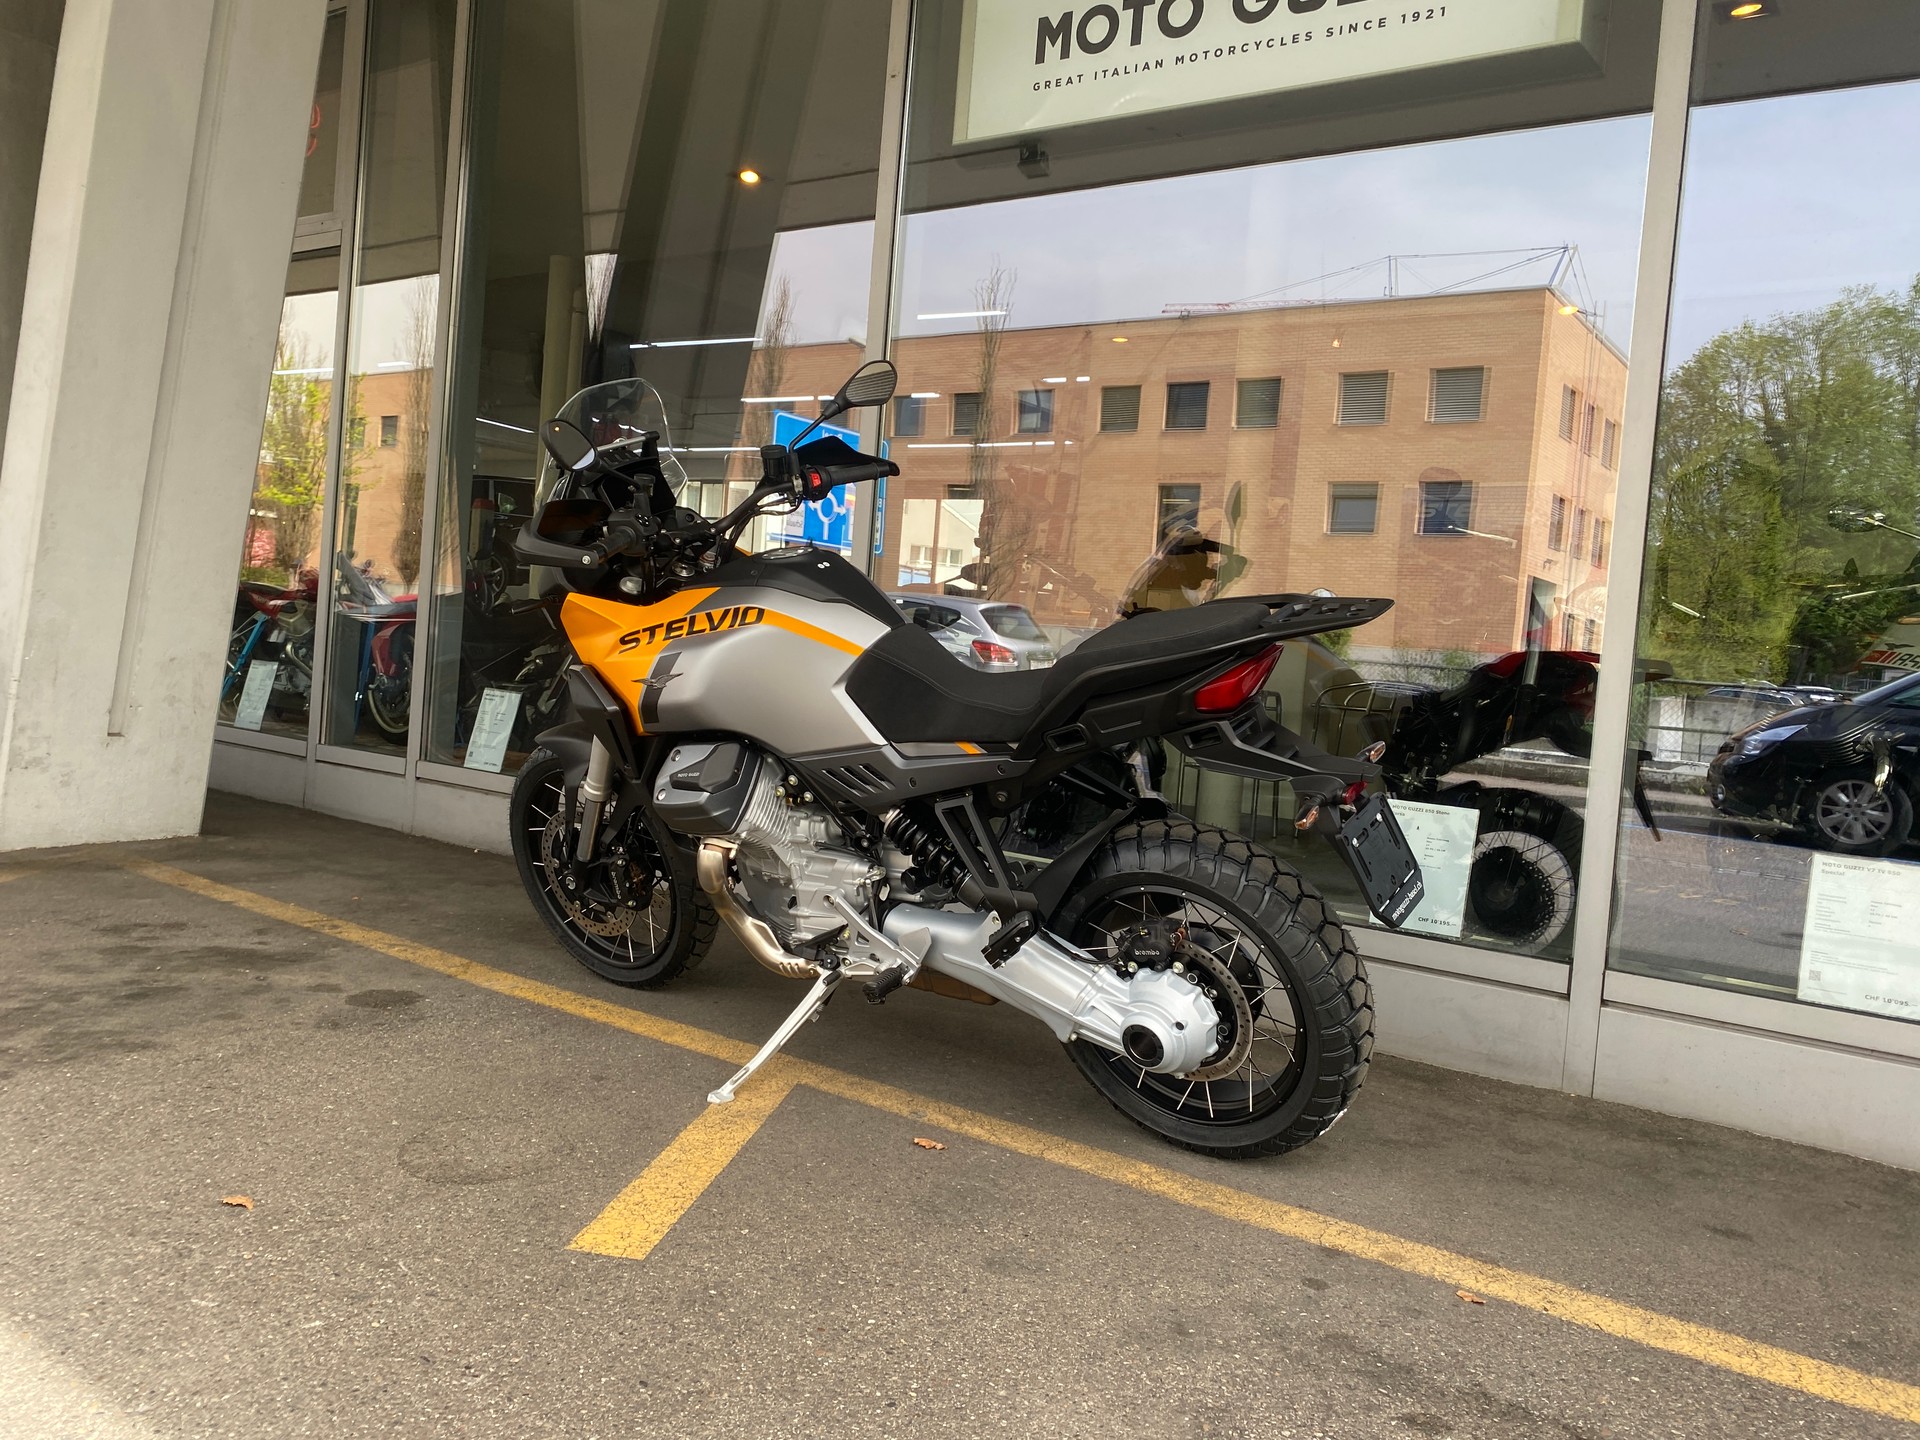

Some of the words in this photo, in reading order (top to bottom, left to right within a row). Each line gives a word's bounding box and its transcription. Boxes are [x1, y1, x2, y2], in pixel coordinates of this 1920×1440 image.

[1033, 74, 1084, 91] GREAT
[1094, 59, 1164, 81] ITALIAN
[1175, 32, 1313, 66] MOTORCYCLES
[1325, 17, 1387, 38] SINCE
[1400, 6, 1447, 25] 1921
[1035, 0, 1205, 65] MOTO
[618, 606, 766, 654] STELVIO
[1134, 948, 1160, 956] brembo
